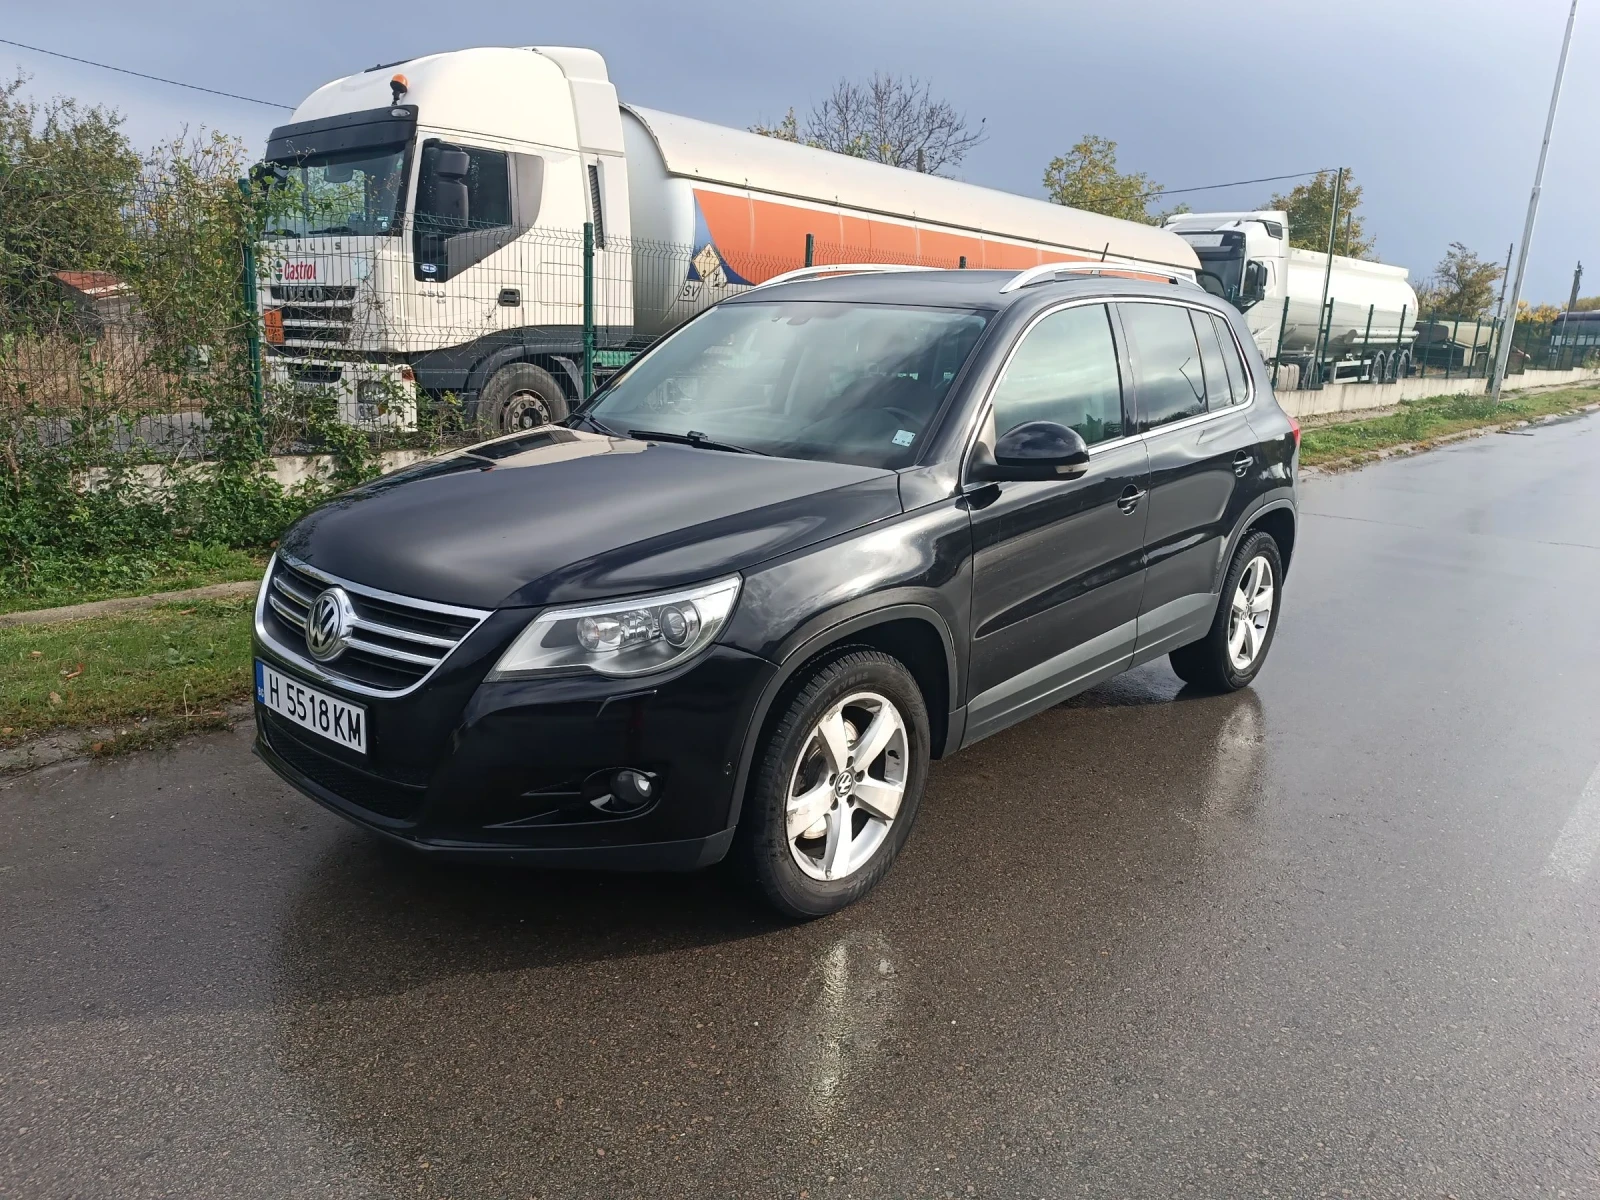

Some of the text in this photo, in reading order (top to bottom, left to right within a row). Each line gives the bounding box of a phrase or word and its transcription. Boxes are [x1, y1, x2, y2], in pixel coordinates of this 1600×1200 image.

[284, 261, 317, 280] Castrol
[283, 286, 323, 302] IVECO
[683, 285, 700, 297] SV
[269, 673, 280, 708] H
